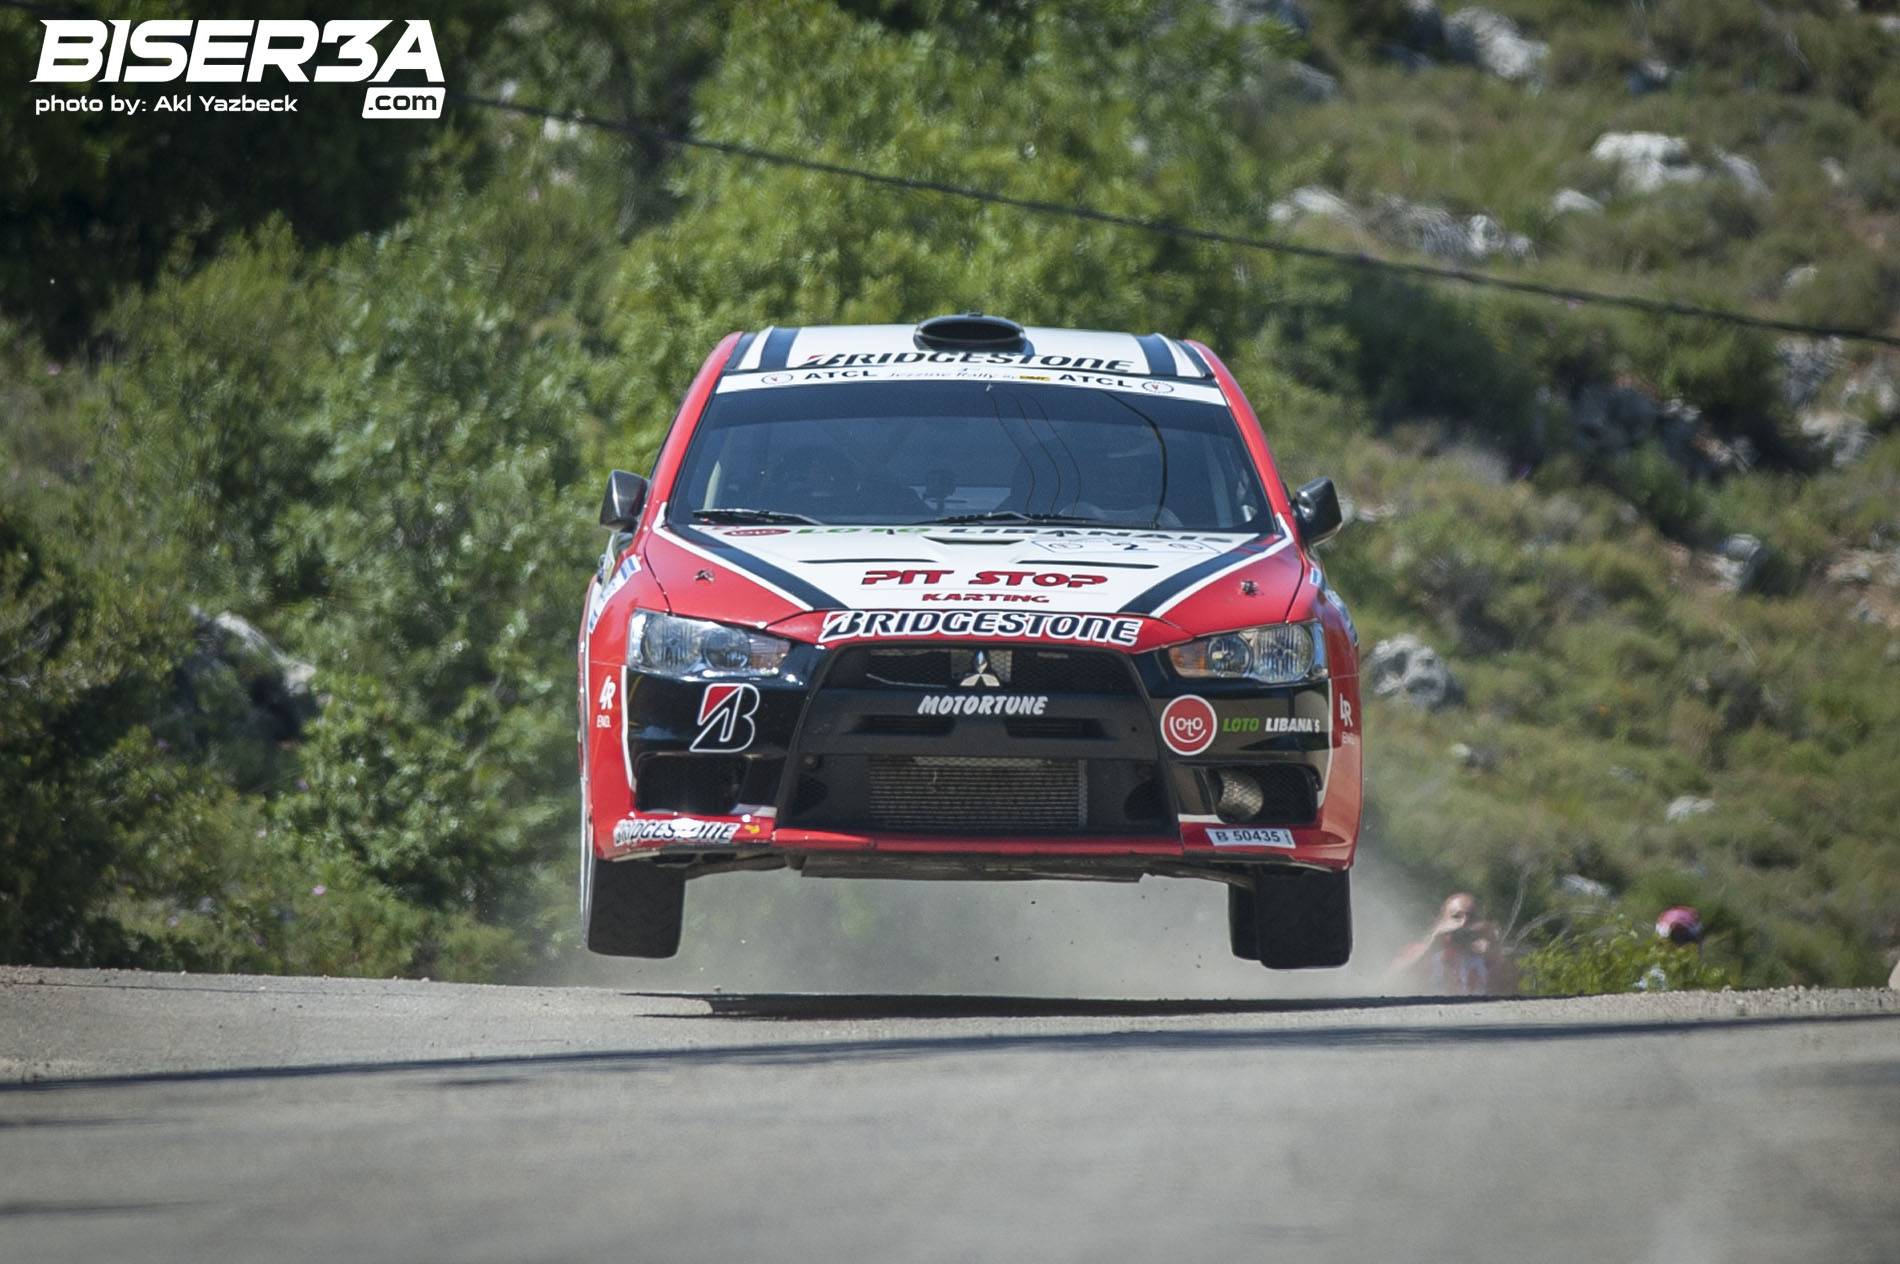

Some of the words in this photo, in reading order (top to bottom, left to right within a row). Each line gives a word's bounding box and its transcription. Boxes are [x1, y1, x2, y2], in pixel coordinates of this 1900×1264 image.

[801, 351, 1136, 373] BRIDGESTONE
[804, 370, 879, 380] ATCL
[1058, 373, 1133, 388] ATCL
[861, 569, 955, 586] PIT
[967, 570, 1108, 588] STOP
[921, 592, 1050, 604] KARTING
[818, 610, 1144, 646] BRIDGESTONE
[917, 695, 1049, 715] MOTORTUNE
[1222, 717, 1260, 733] LOTO
[613, 818, 741, 848] BRIDGESNE
[1215, 831, 1229, 841] B
[1233, 830, 1281, 843] 50435
